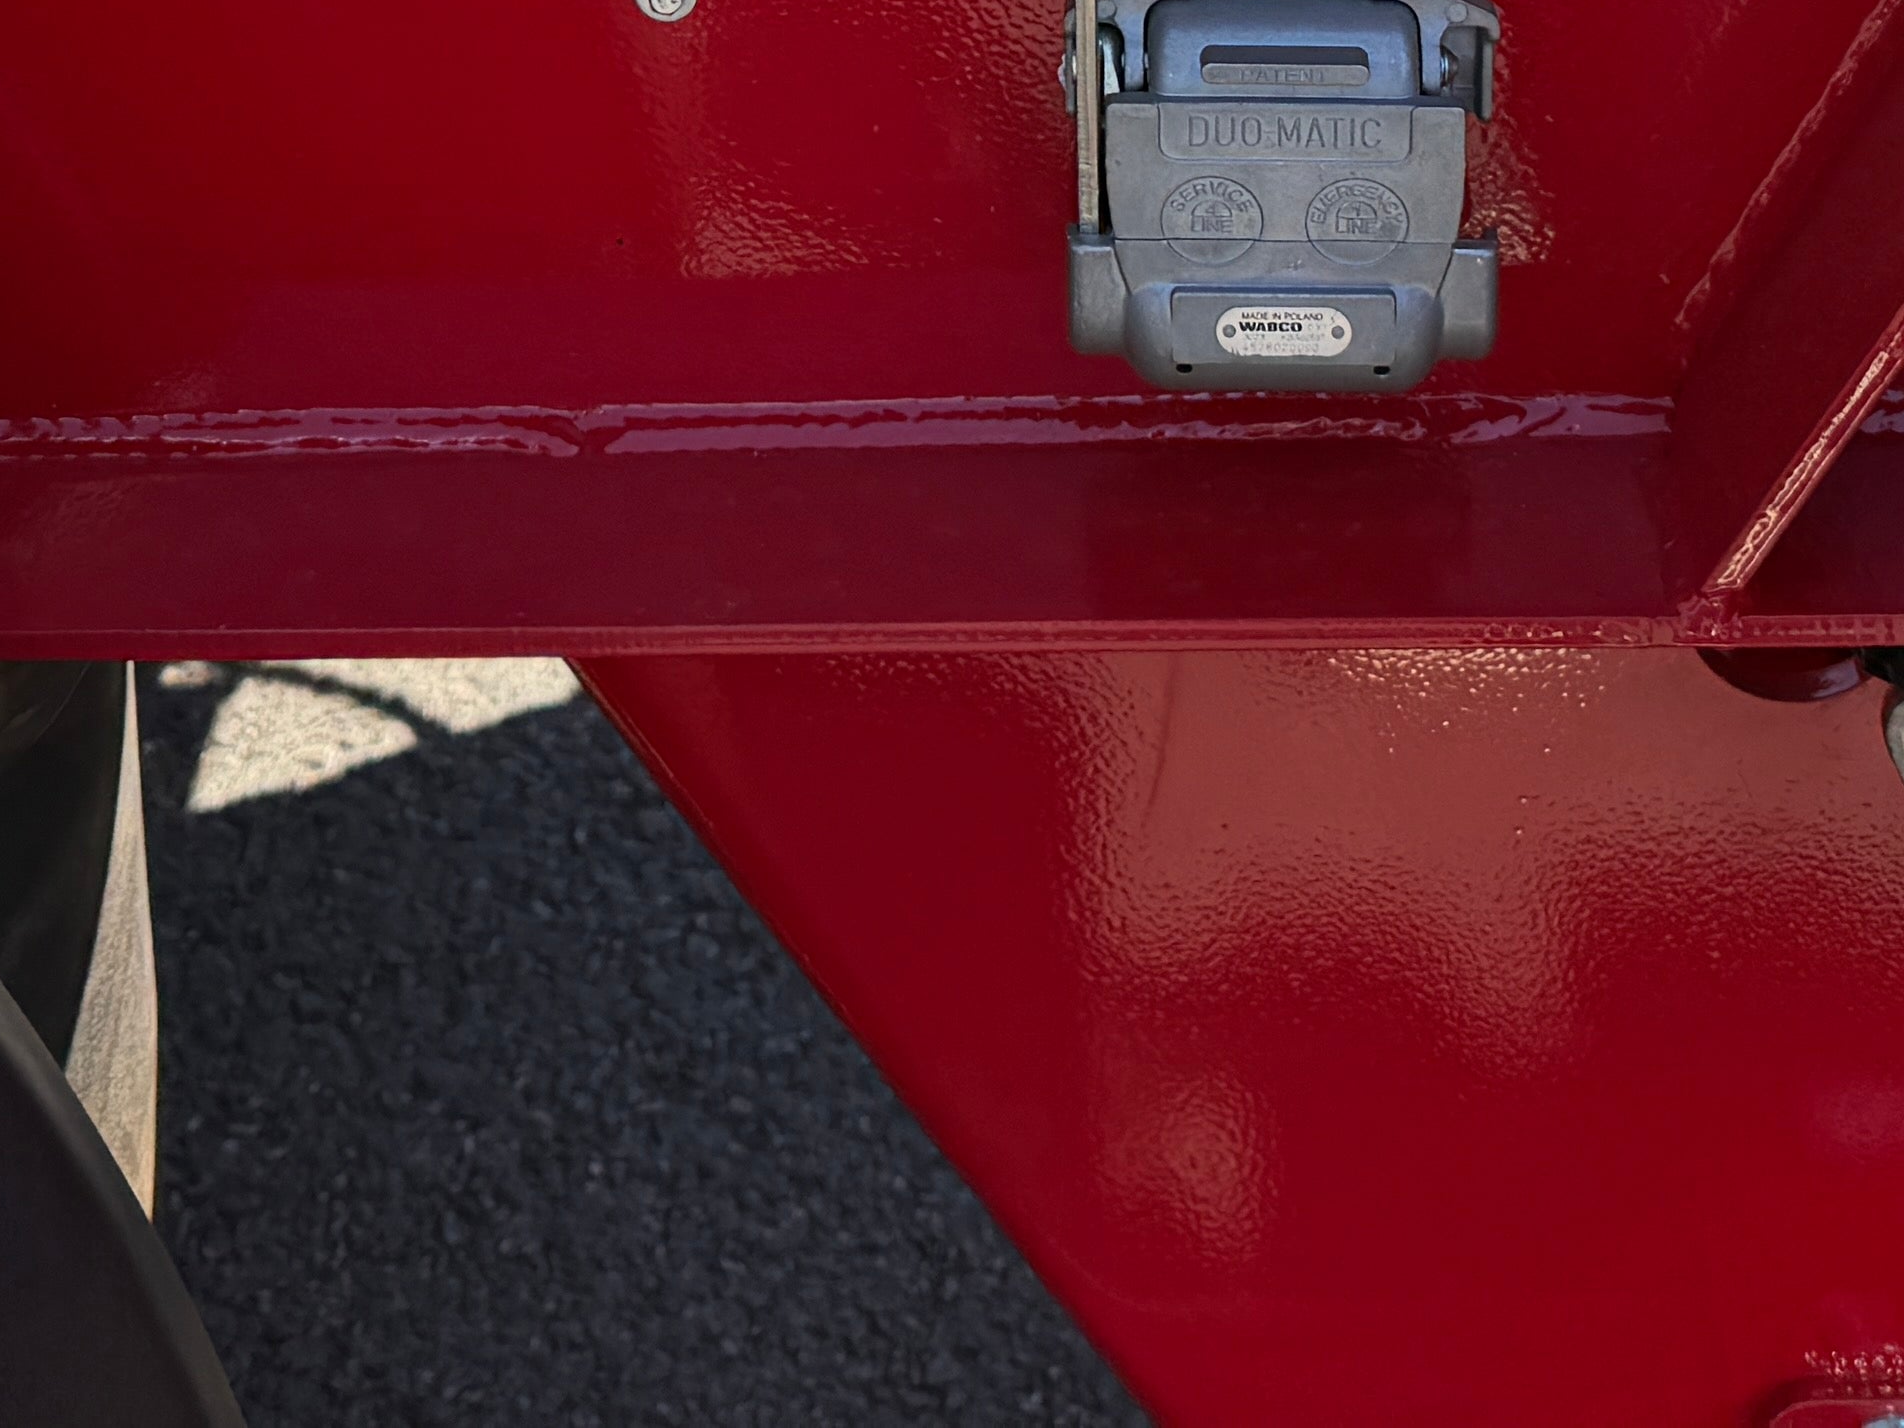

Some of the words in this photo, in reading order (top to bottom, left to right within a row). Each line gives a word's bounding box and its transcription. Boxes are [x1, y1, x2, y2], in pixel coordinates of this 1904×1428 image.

[1188, 114, 1383, 150] DUO-MATIC
[1170, 179, 1255, 214] SERVICE
[1309, 183, 1404, 226] EMERGENCY
[1190, 215, 1234, 234] LINE
[1335, 217, 1378, 235] LINE
[1238, 321, 1303, 333] WABCO
